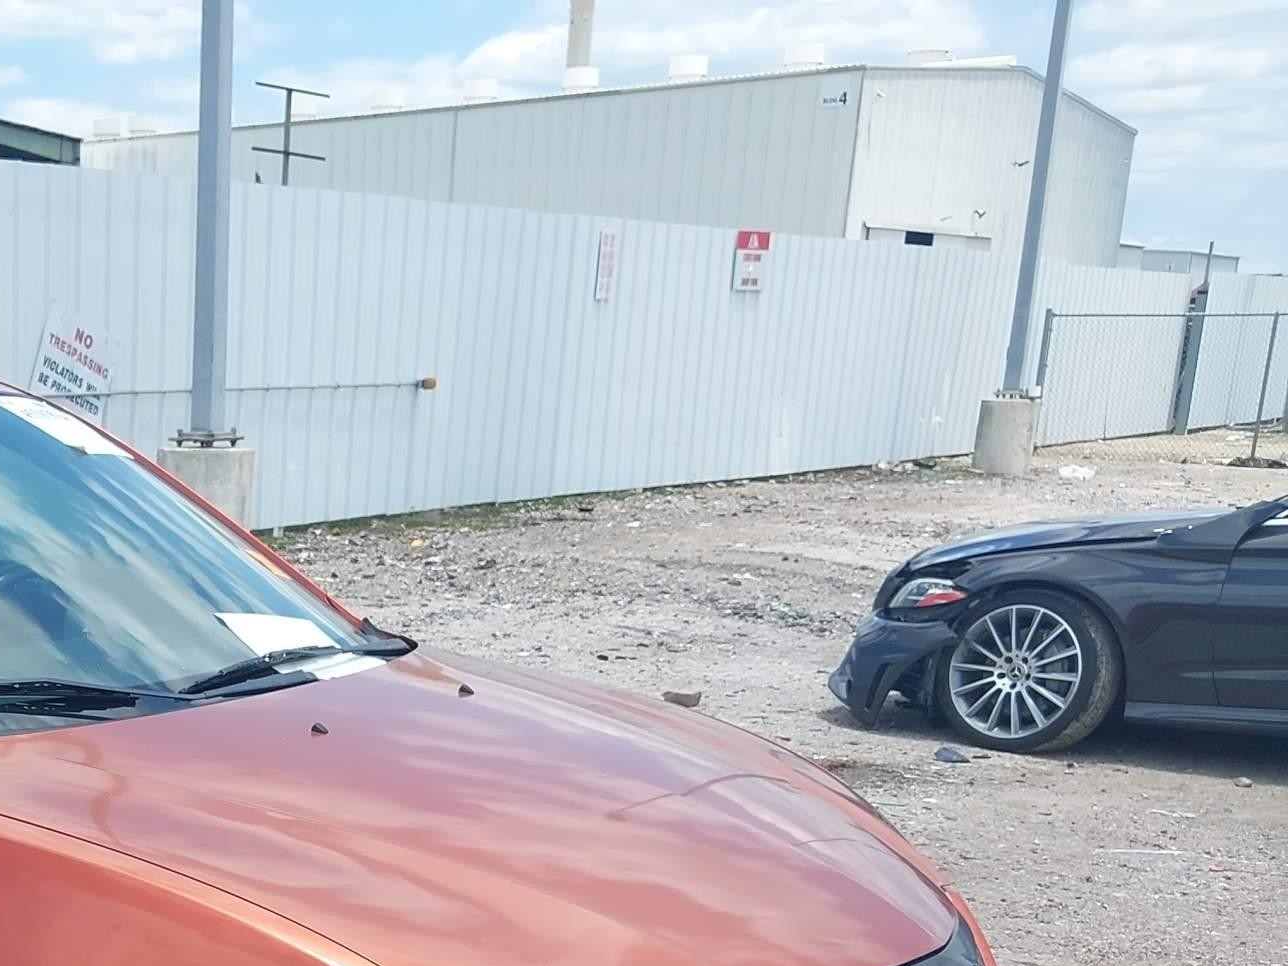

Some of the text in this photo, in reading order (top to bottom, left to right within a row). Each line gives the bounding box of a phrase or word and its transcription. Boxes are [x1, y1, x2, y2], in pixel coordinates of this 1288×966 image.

[838, 91, 848, 105] 4
[74, 327, 94, 350] NO
[48, 332, 109, 380] TRESPASSING
[37, 371, 50, 387] BE
[42, 354, 84, 389] VIOLATORS
